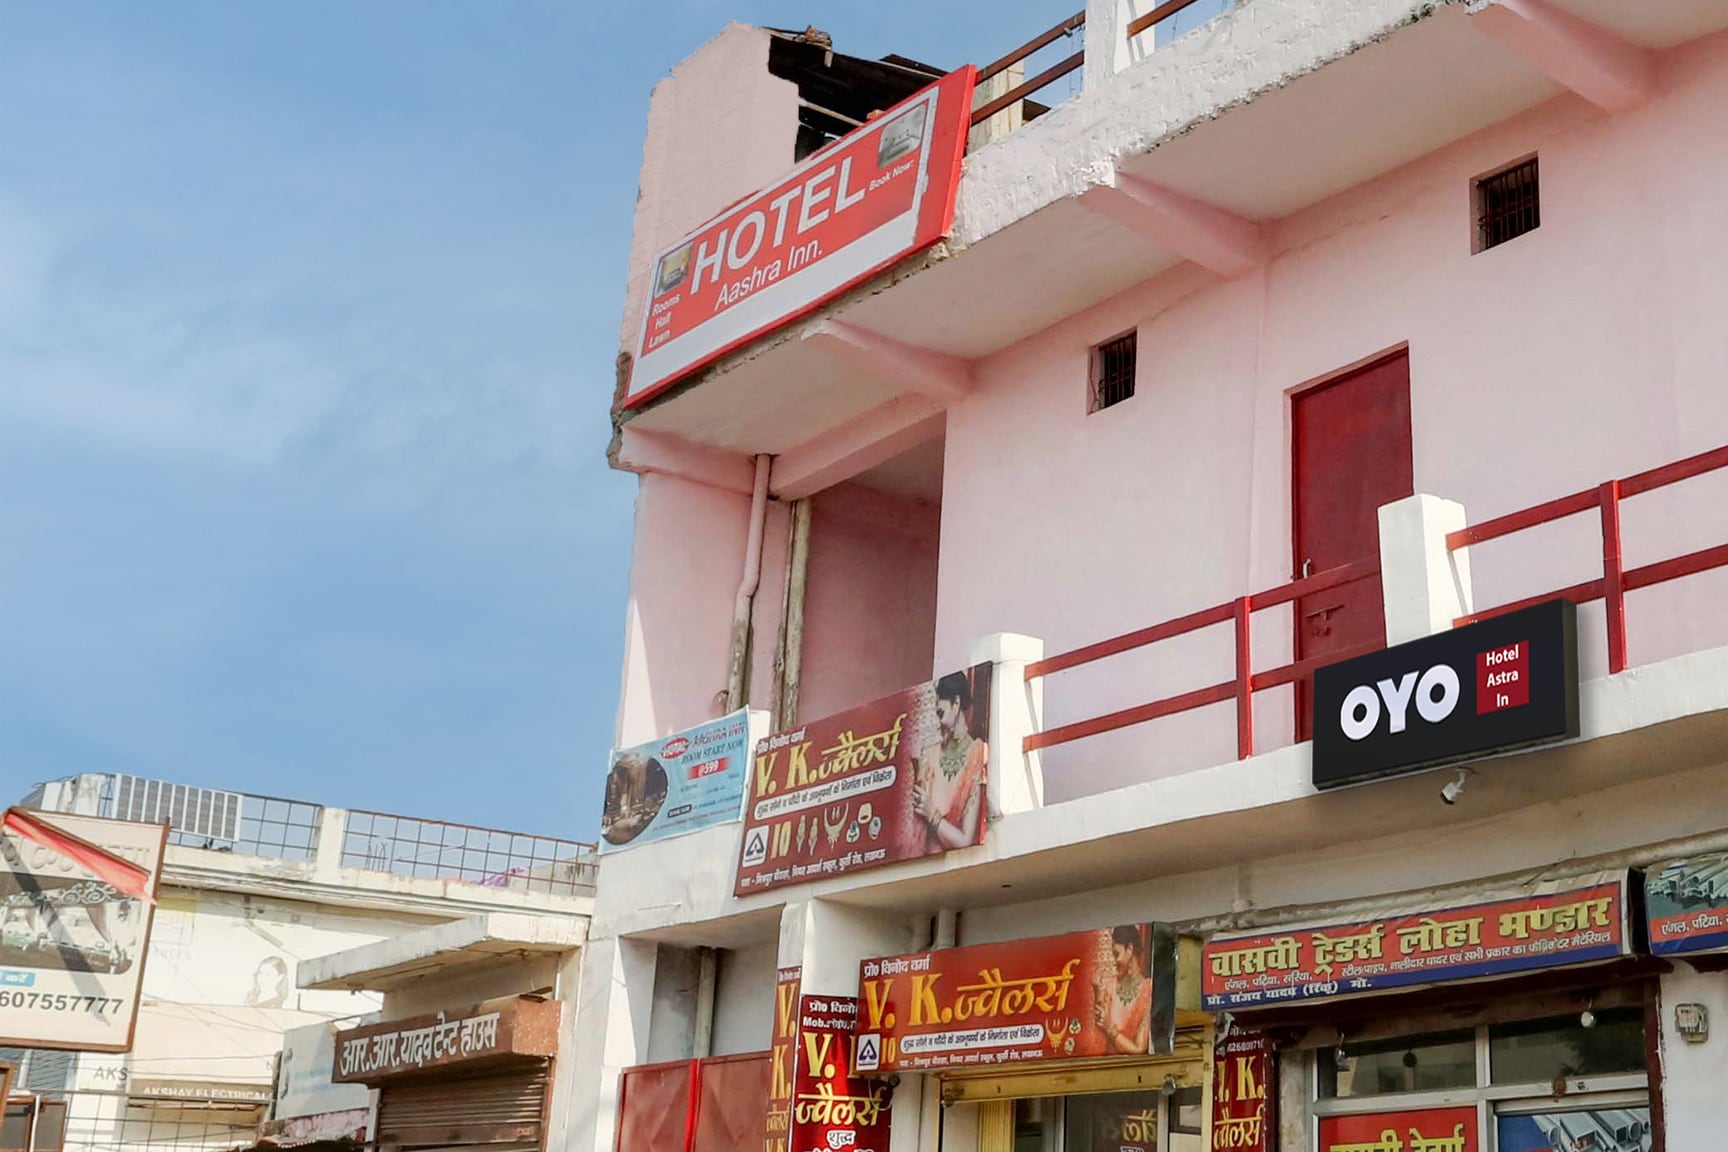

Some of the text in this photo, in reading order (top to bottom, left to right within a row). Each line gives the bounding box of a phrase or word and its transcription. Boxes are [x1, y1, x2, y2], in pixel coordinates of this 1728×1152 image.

[868, 171, 892, 192] Book
[690, 155, 866, 295] HOTEL
[714, 238, 824, 312] Aashra Inn.
[1485, 644, 1519, 667] Hotel
[1486, 668, 1519, 688] Astra
[1340, 664, 1460, 741] OYO
[1496, 694, 1509, 708] In
[755, 752, 778, 798] V.
[785, 741, 818, 790] K.
[1209, 896, 1613, 976] वासवी ट्रेडर्स लोहा भण्डार
[830, 1000, 857, 1014] विनो
[863, 973, 953, 1030] V. K.
[953, 959, 1081, 1022] ज्वैलर्स
[460, 1012, 501, 1057] हाउस
[802, 1032, 836, 1079] V.
[1236, 1055, 1265, 1101] K.
[795, 1081, 888, 1127] ज्वैलर्स
